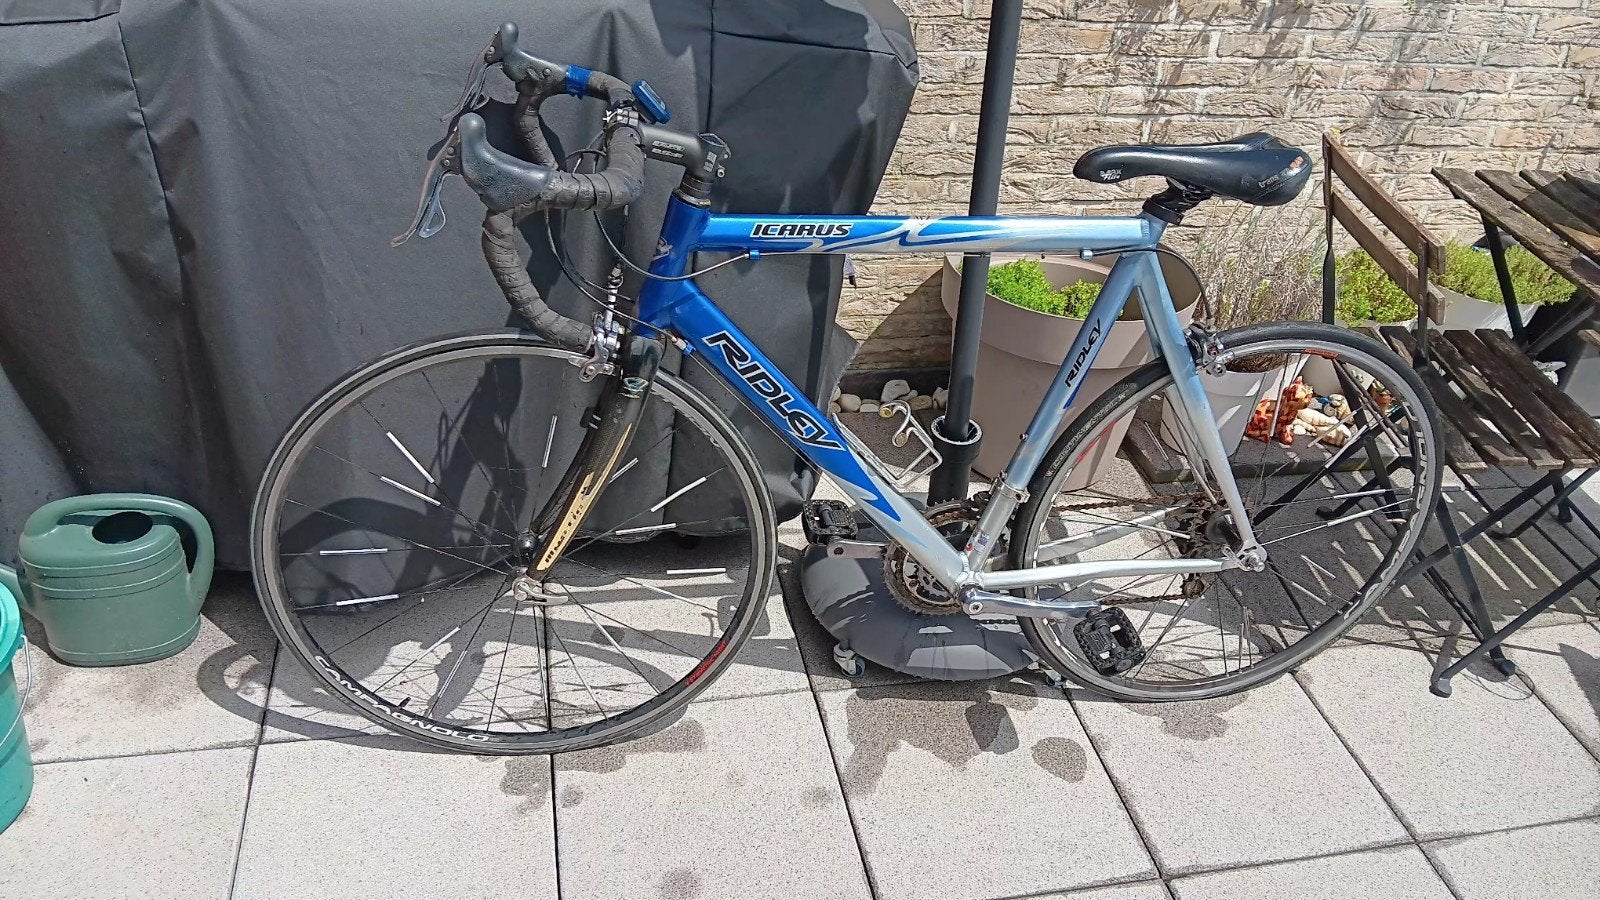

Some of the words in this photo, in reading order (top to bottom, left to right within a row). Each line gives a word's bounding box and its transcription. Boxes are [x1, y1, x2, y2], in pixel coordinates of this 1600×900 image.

[1258, 174, 1279, 188] trans
[750, 223, 854, 238] ICARUS
[1064, 317, 1101, 388] RIDLEY
[702, 330, 846, 451] RIDLEY
[315, 655, 490, 742] CAMPAGNOLO
